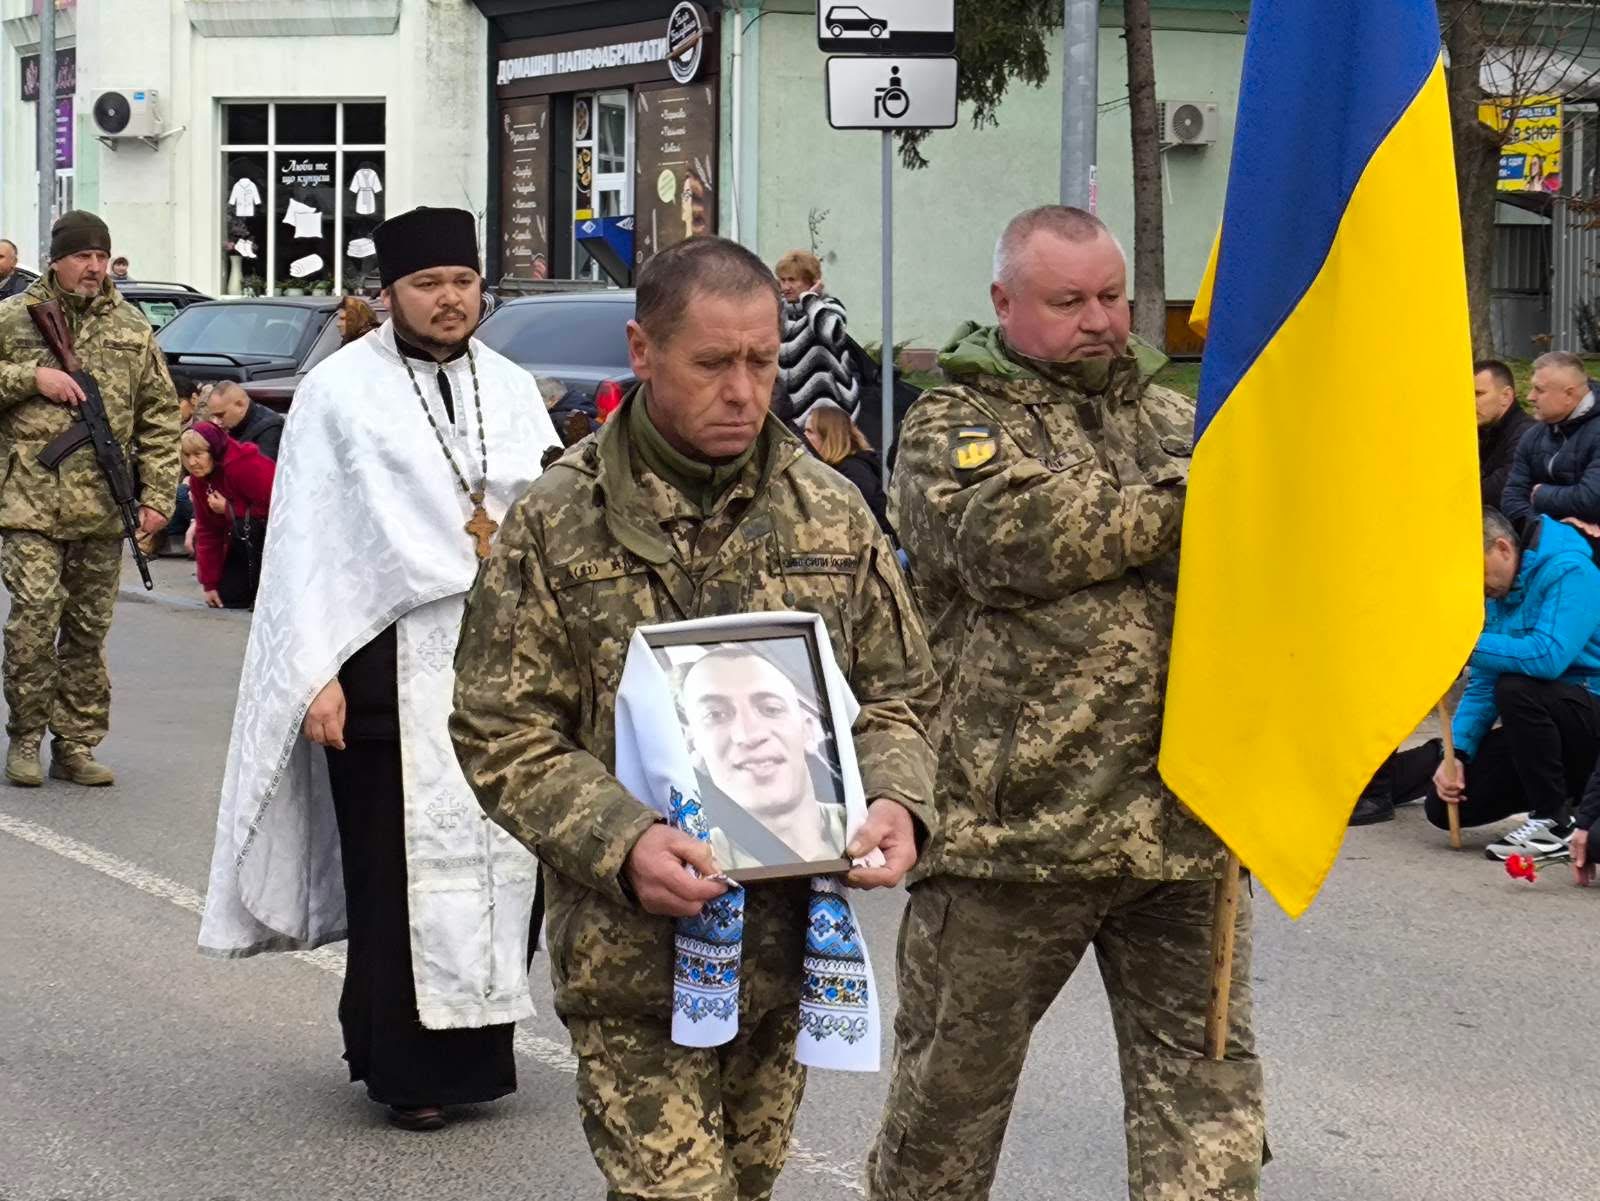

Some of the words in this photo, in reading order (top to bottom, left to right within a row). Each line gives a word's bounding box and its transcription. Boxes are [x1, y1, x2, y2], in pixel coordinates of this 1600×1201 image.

[496, 54, 553, 85] ДОМАШНІ
[557, 37, 668, 74] НАПІВФАБРИКАТИ
[1525, 125, 1556, 141] SHOP
[281, 159, 313, 173] Люби
